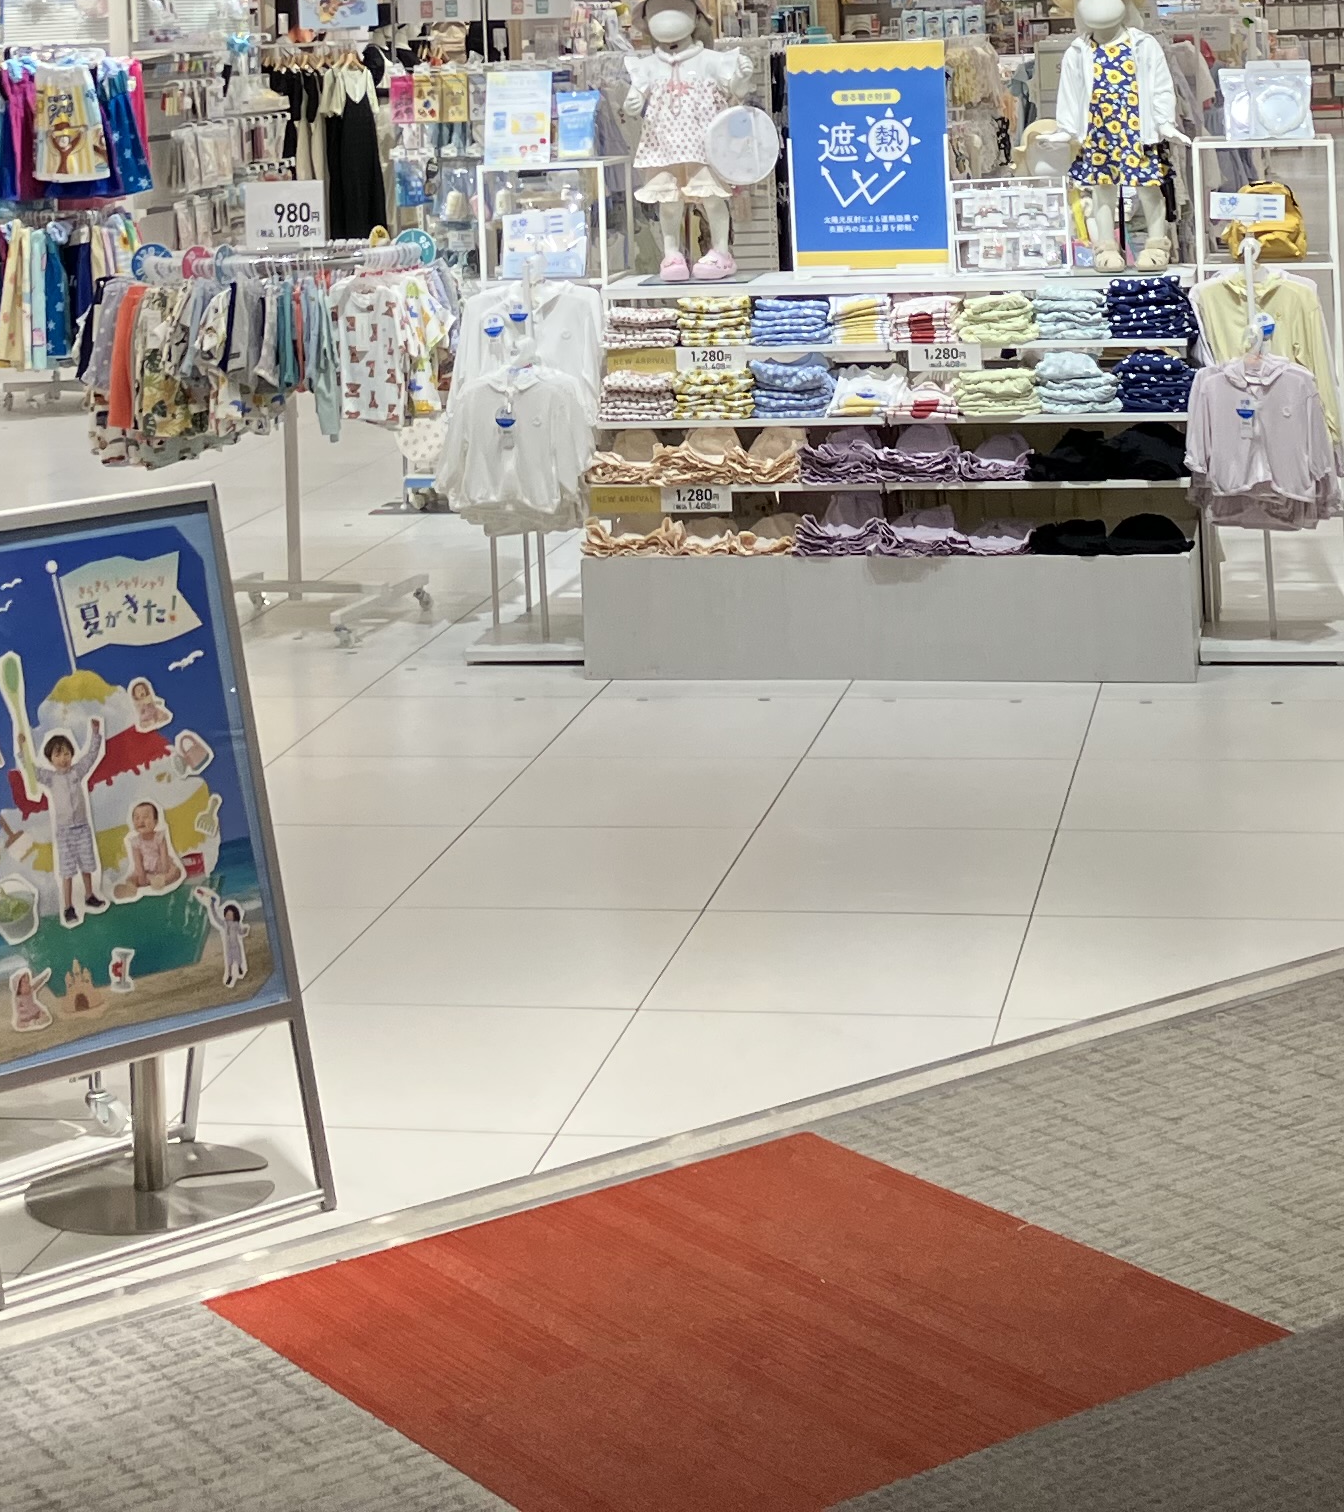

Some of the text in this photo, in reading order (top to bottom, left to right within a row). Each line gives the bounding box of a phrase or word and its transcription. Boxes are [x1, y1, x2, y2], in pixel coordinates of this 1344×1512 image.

[817, 121, 904, 162] 遮熱
[274, 202, 320, 224] 980円
[691, 350, 732, 362] 1,280円
[924, 347, 967, 360] 1,280円
[675, 488, 720, 502] 1,280円
